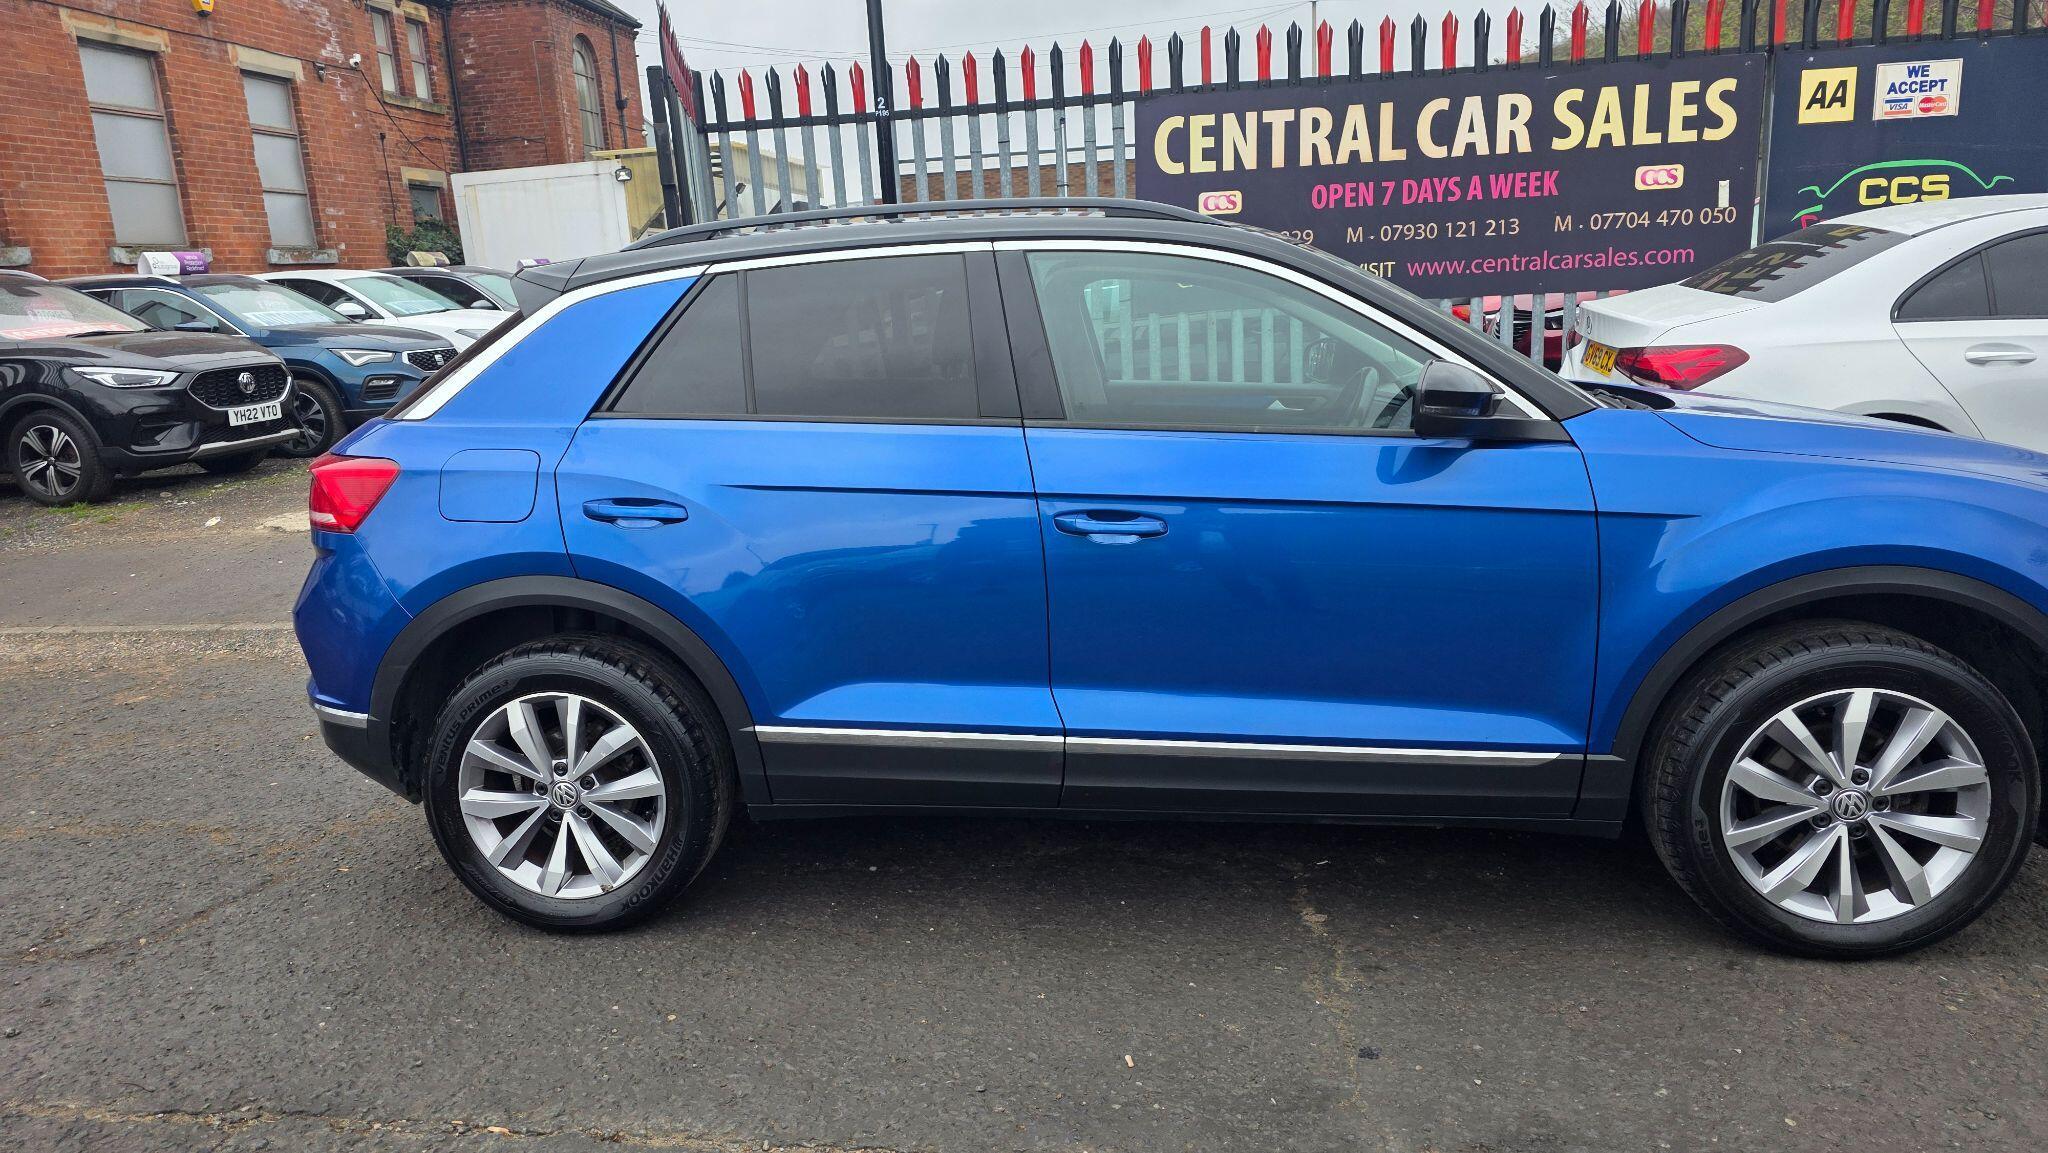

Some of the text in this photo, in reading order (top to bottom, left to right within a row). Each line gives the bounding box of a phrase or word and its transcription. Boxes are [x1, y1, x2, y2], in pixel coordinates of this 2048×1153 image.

[1907, 65, 1930, 78] WE
[1805, 79, 1848, 111] AA
[1887, 79, 1948, 95] ACCEPT
[877, 97, 886, 108] 2
[1889, 103, 1908, 111] VISA
[1154, 77, 1738, 175] CENTRAL CAR SALES
[1640, 168, 1679, 186] CCS
[1312, 170, 1559, 210] OPEN 7 DAYS A WEEK
[1859, 174, 1950, 206] CCS
[1203, 194, 1238, 212] CCS
[1554, 215, 1572, 232] M
[1590, 211, 1650, 230] 07704
[1656, 208, 1693, 226] 470
[1700, 206, 1737, 224] 050
[1346, 226, 1363, 243] M
[1380, 222, 1438, 242] 07930
[1445, 220, 1475, 238] 121
[1485, 218, 1520, 236] 213
[1359, 247, 1695, 278] ISIT www.centralcarsales.com
[233, 404, 278, 423] YH22 VTO
